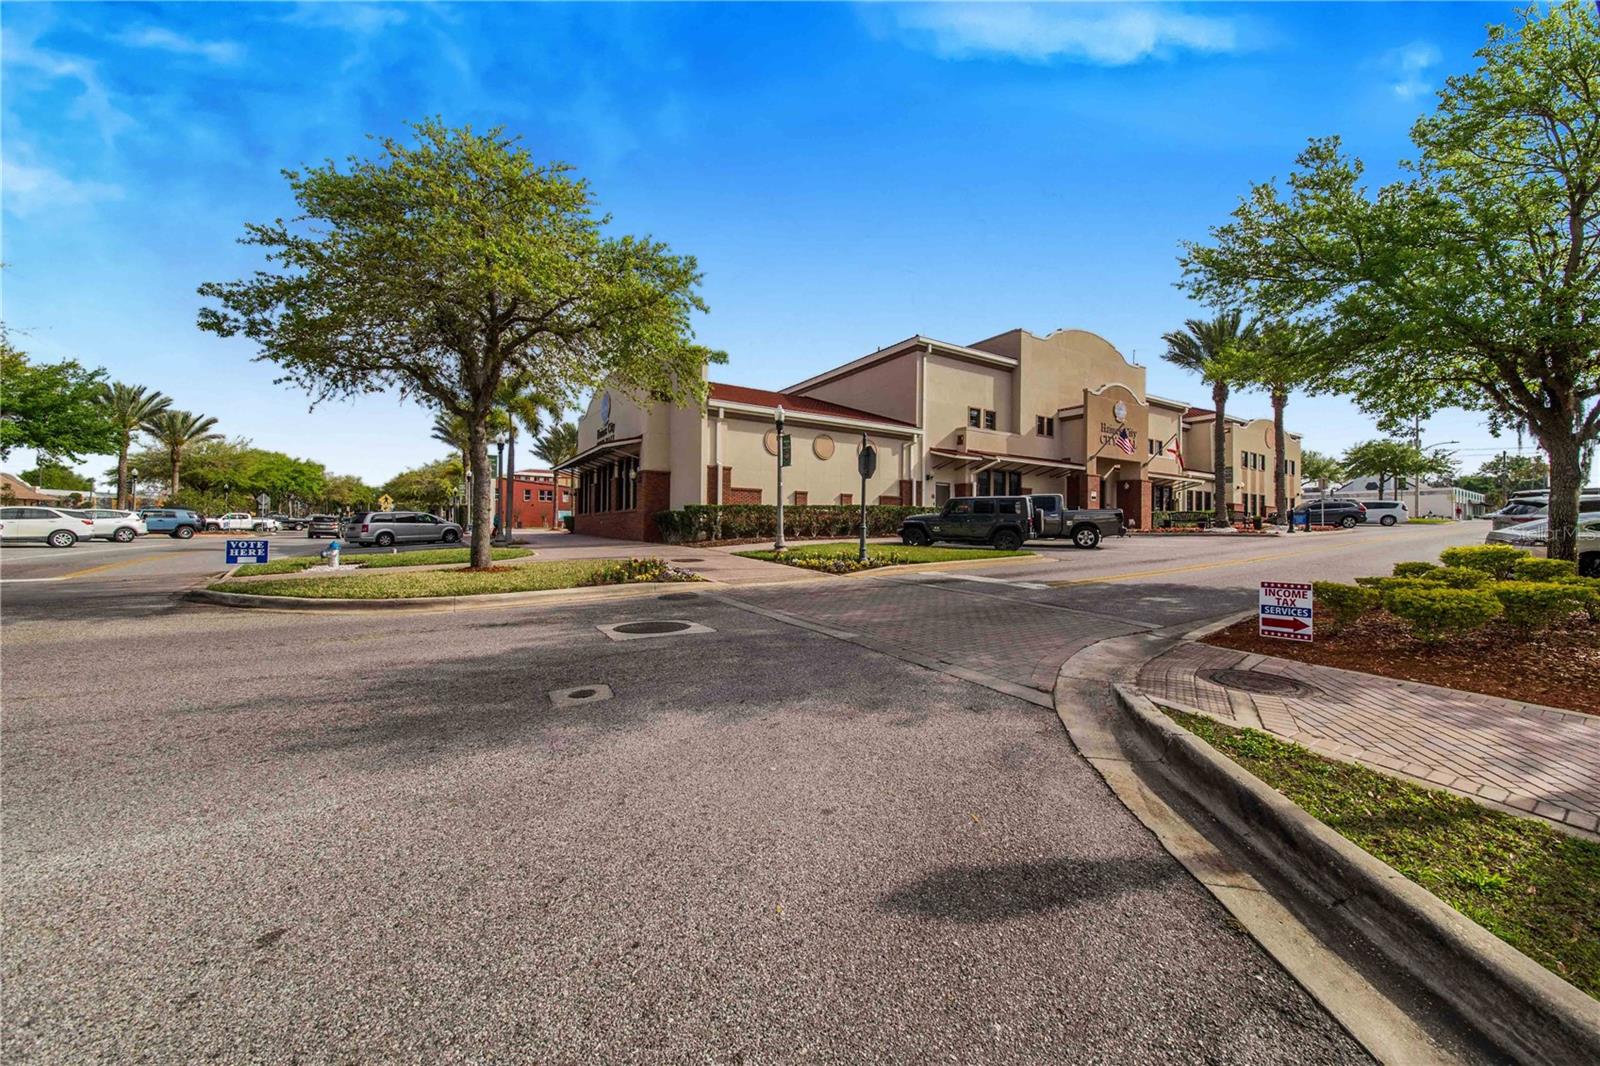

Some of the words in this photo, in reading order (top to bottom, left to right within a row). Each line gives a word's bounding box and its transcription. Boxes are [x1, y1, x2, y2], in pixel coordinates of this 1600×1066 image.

[229, 548, 265, 556] HERE
[1265, 588, 1308, 599] INCOME
[1275, 598, 1297, 607] TAX
[1264, 606, 1309, 617] SERVICES
